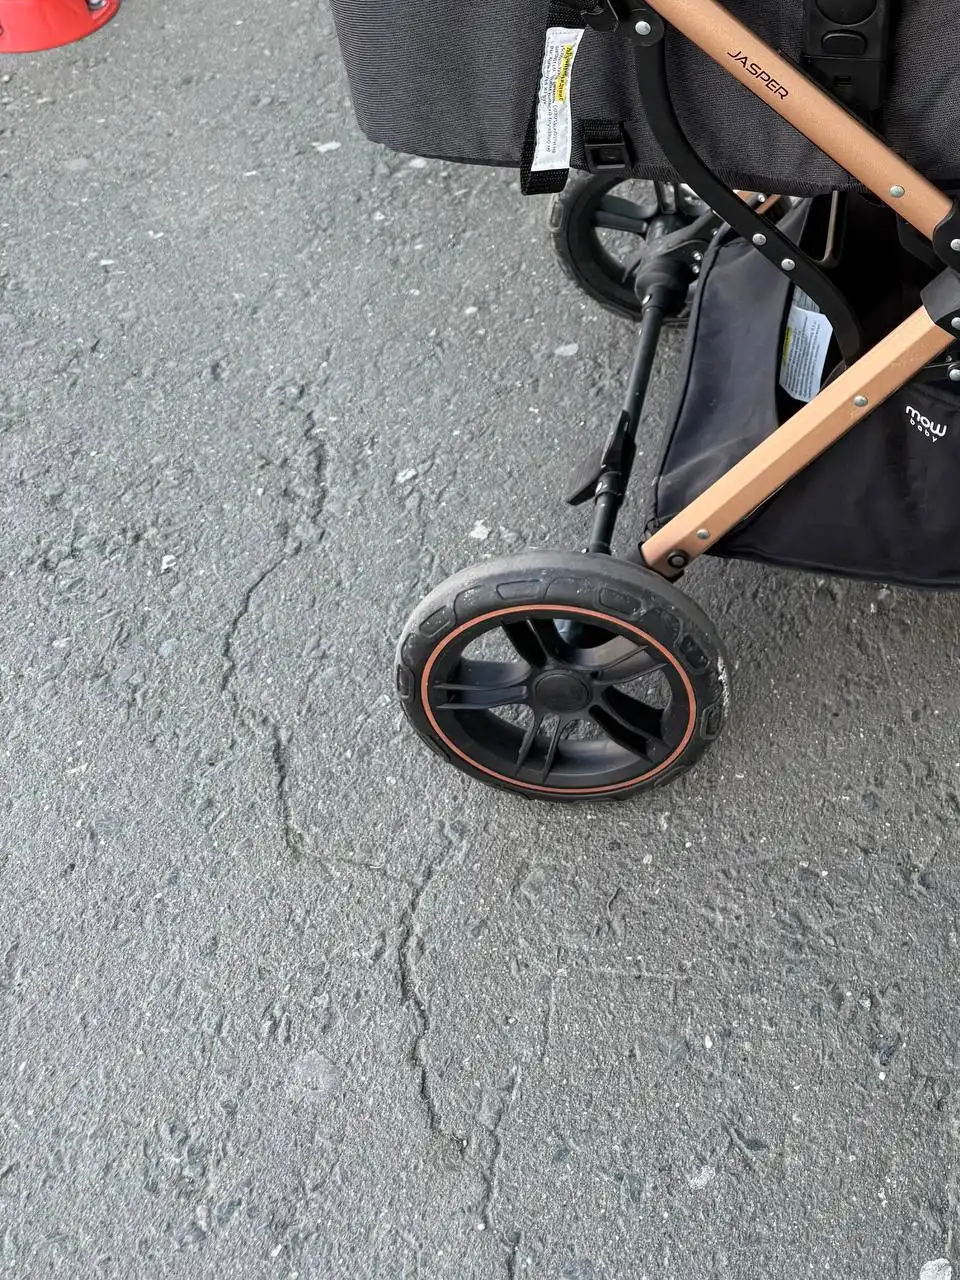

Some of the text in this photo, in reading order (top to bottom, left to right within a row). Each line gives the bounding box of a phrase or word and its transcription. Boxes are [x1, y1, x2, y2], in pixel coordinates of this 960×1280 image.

[727, 51, 789, 100] JASPER
[906, 406, 947, 437] mow
[910, 418, 938, 443] baby
